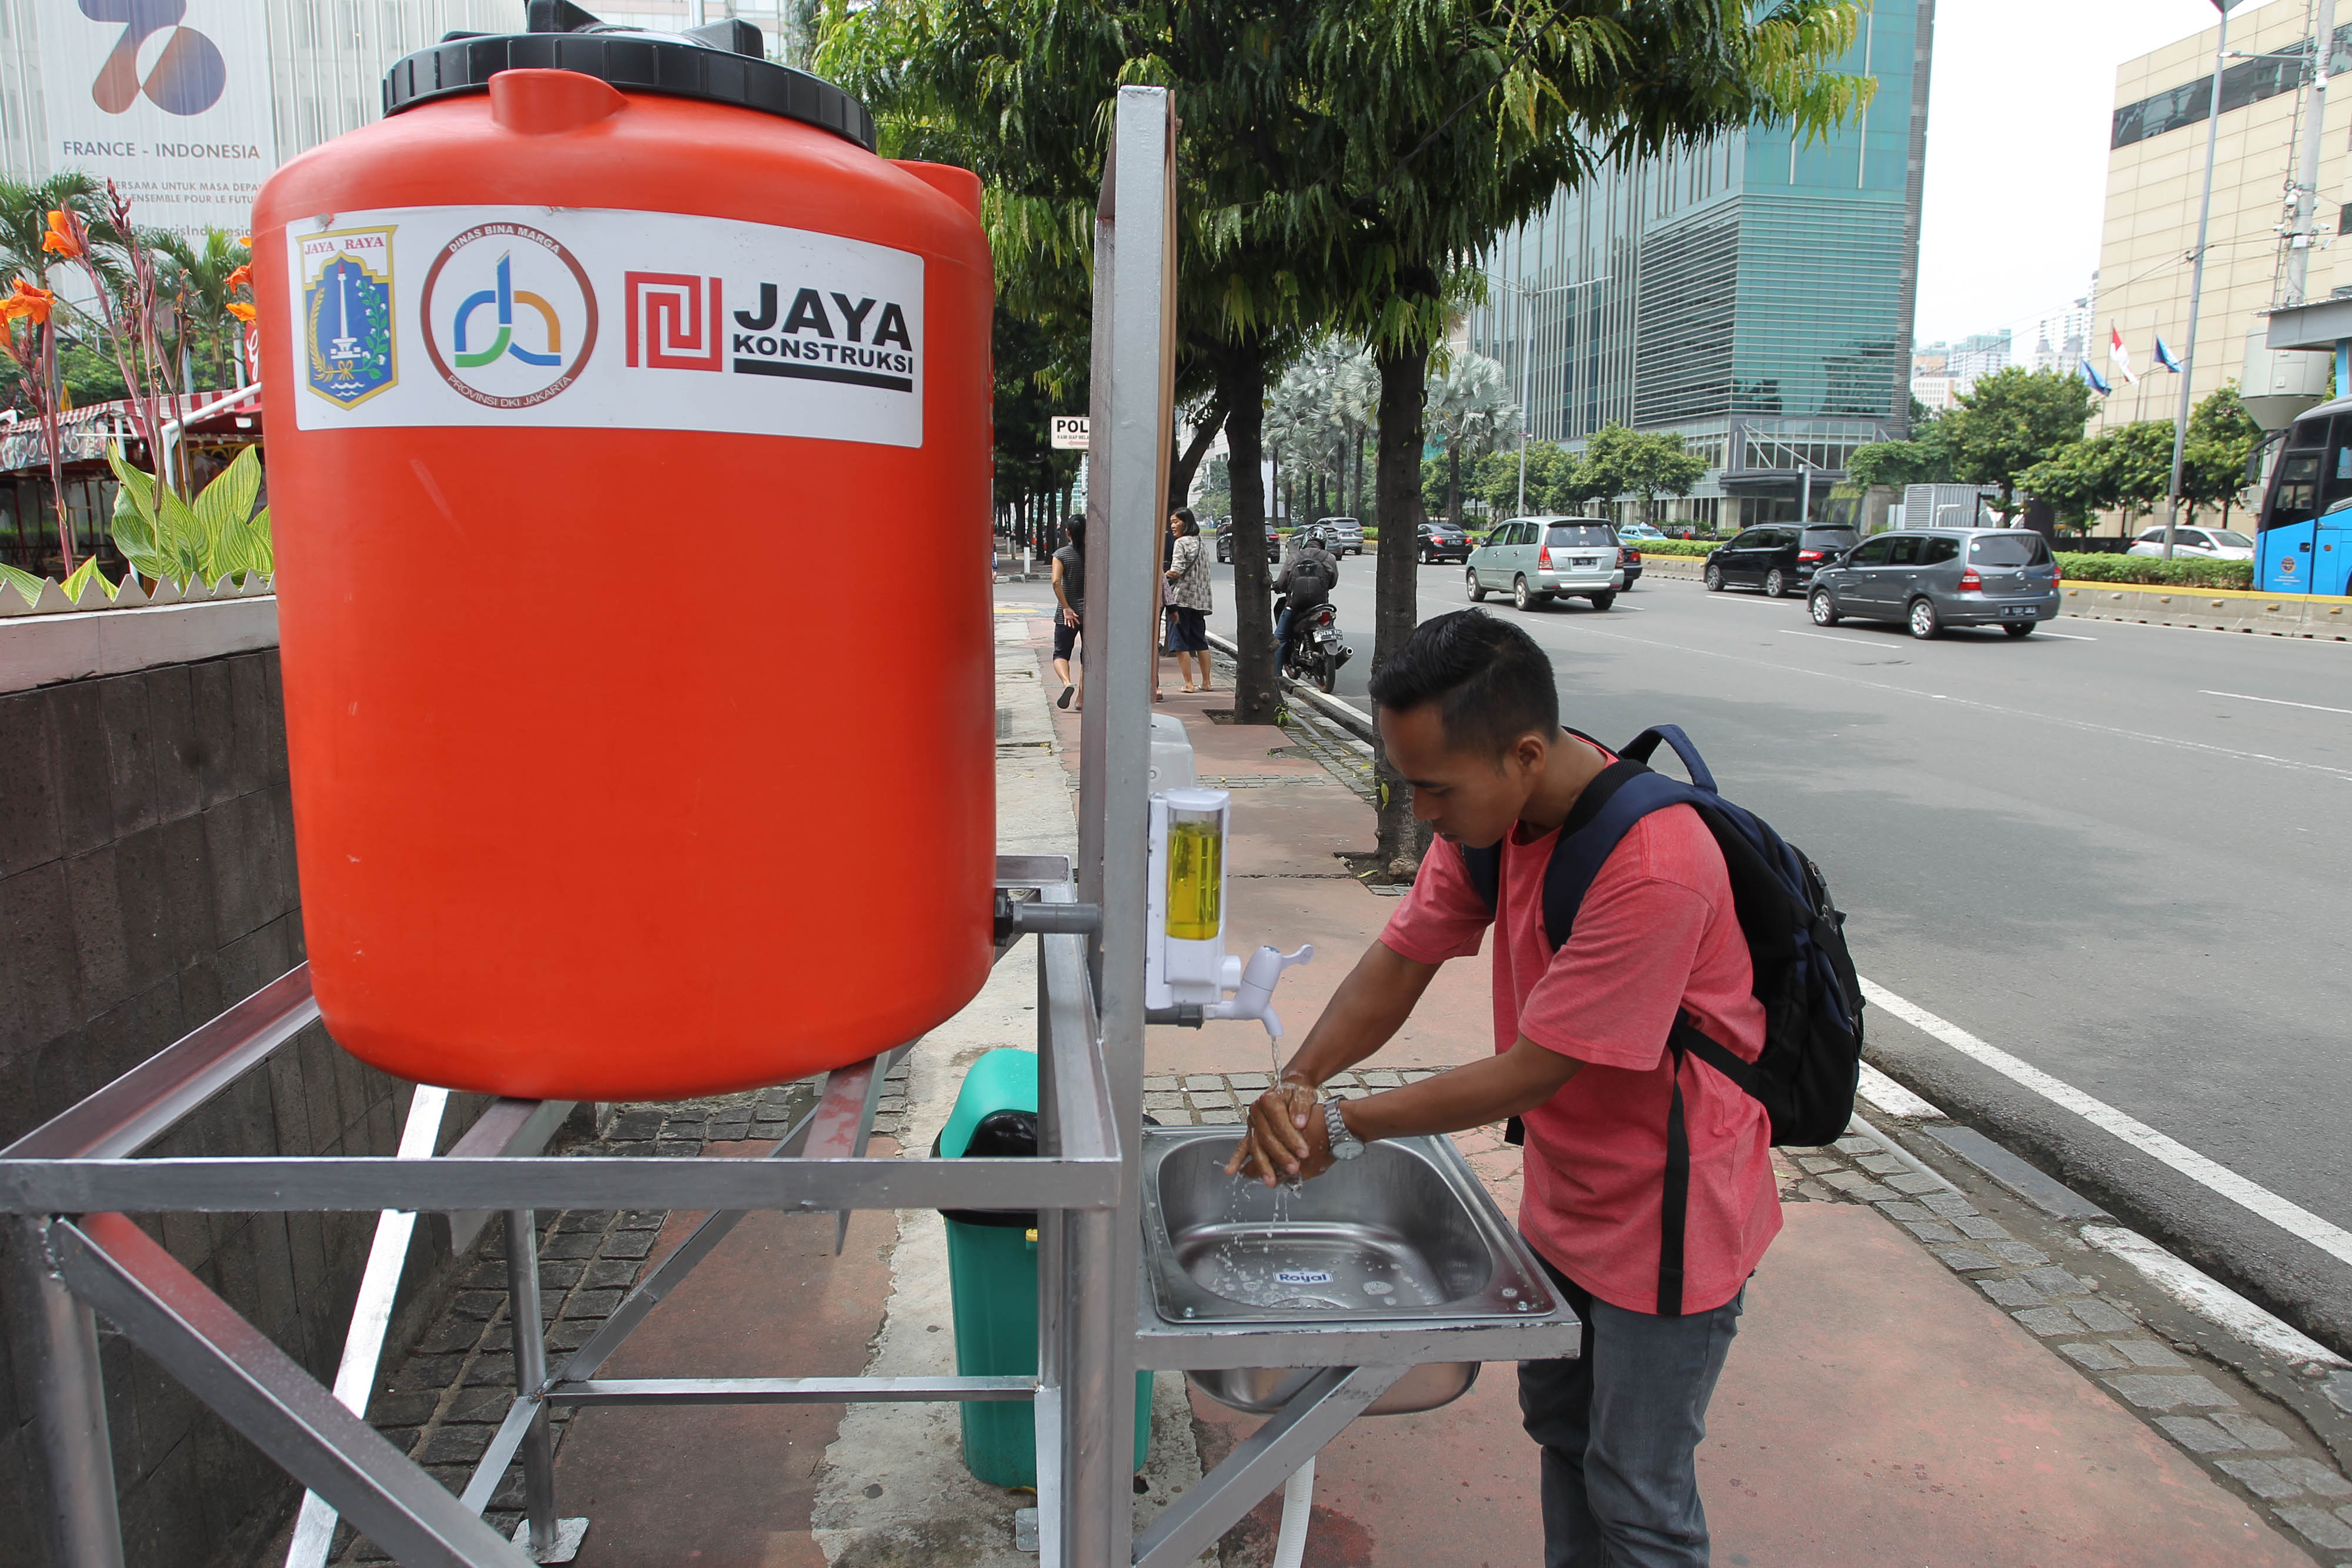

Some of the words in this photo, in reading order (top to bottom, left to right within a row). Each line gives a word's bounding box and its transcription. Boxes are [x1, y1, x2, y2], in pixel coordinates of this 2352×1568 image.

[63, 141, 136, 156] FRANCE
[156, 143, 260, 159] INDONESIA
[115, 181, 158, 190] ERSAMA
[162, 182, 196, 191] UNTUK
[200, 182, 229, 192] MASA
[132, 194, 181, 203] ENSEMBLE
[185, 195, 212, 204] POUR
[216, 195, 226, 204] LE
[229, 195, 253, 205] FUTU
[305, 240, 335, 256] JAYA
[345, 236, 385, 250] RAYA
[449, 228, 482, 253] DINAS
[485, 225, 514, 235] BINA
[517, 226, 560, 254] MARGA
[733, 282, 913, 352] JAYA
[733, 333, 913, 374] KONSTRUKSI
[447, 375, 497, 406] PROVINSI
[500, 397, 521, 407] DKI
[523, 375, 572, 406] JAKARTA
[1057, 420, 1088, 433] POL
[1279, 1273, 1327, 1282] Royal
